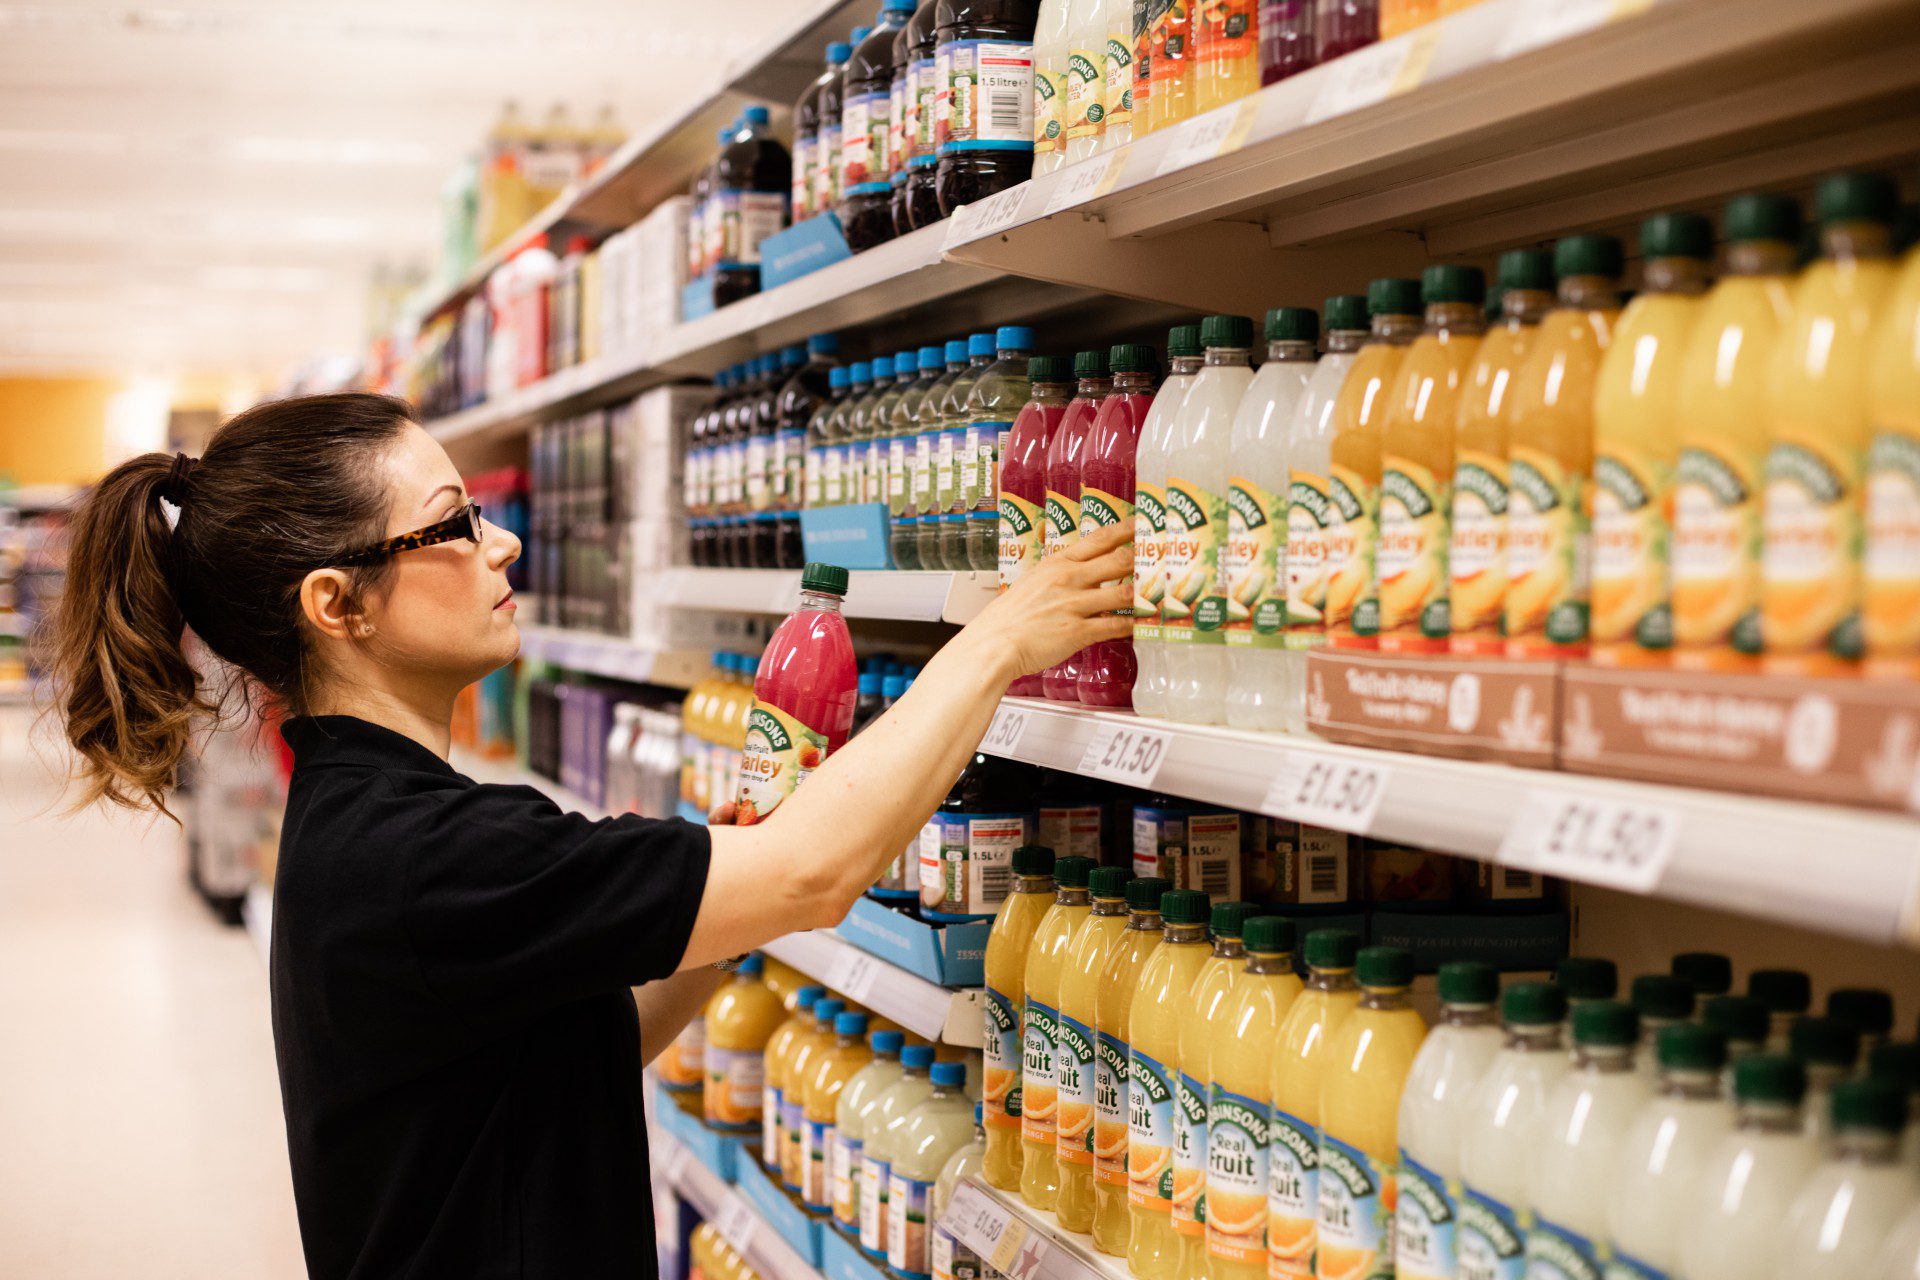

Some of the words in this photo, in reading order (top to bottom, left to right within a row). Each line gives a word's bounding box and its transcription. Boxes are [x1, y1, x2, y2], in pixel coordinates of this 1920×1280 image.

[981, 78, 996, 86] 1.5
[997, 77, 1018, 87] litre
[976, 187, 1027, 230] £1.99
[1101, 730, 1163, 775] £1.50
[1295, 762, 1377, 814] £1.50
[973, 851, 993, 861] 1.5L
[1025, 1035, 1045, 1052] Real
[1036, 1070, 1048, 1079] drop
[1215, 1133, 1246, 1153] Real
[1210, 1146, 1254, 1177] Fruit
[974, 1210, 1003, 1242] £1.50
